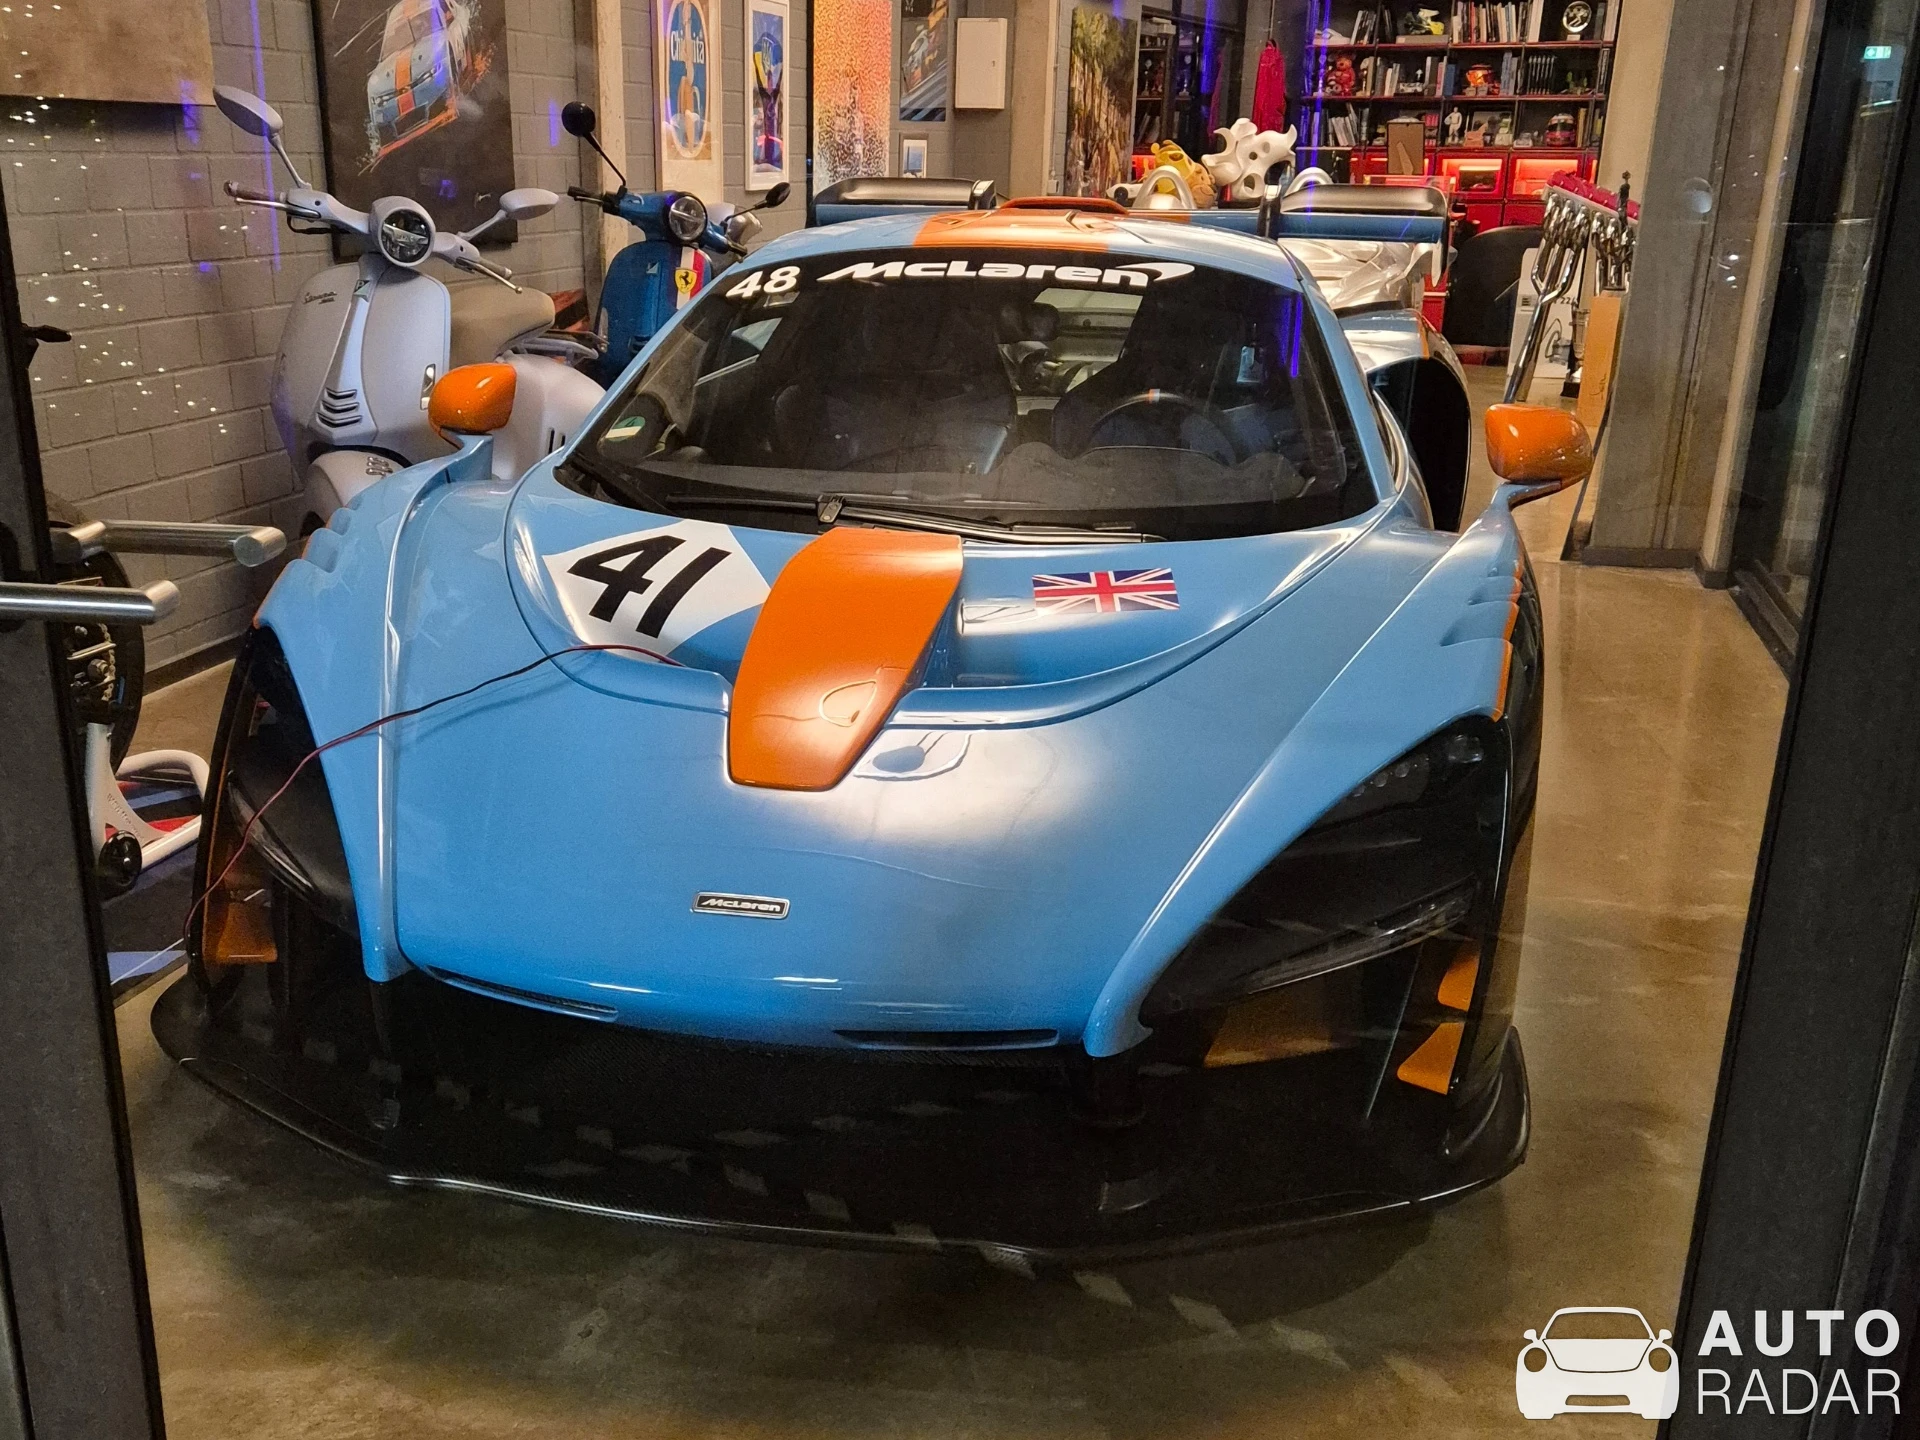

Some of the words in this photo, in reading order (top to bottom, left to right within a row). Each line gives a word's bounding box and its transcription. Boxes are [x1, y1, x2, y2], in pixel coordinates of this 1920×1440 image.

[725, 265, 801, 299] 48
[816, 260, 1149, 288] McLaren
[567, 535, 733, 639] 41
[701, 898, 781, 912] McLaren
